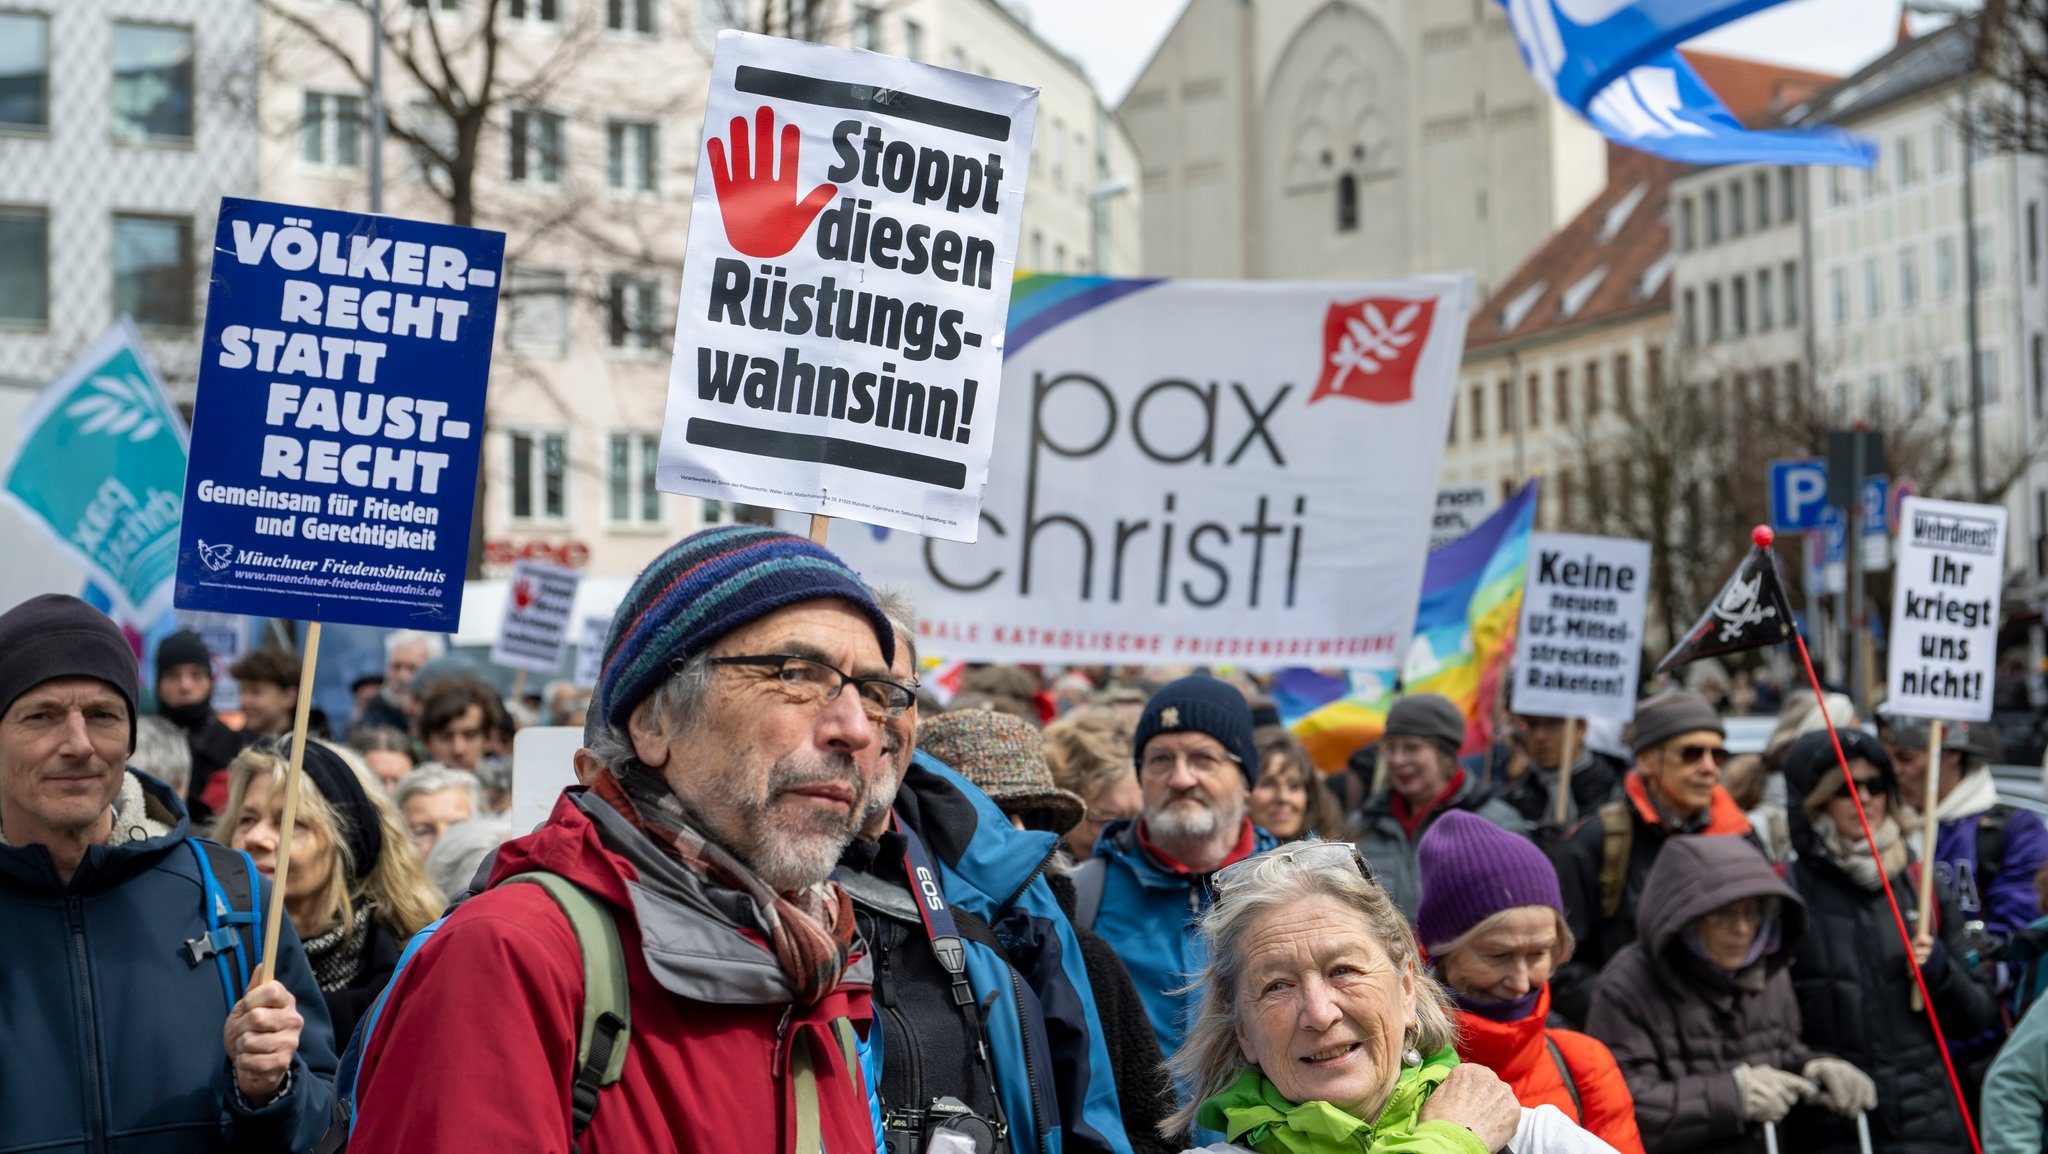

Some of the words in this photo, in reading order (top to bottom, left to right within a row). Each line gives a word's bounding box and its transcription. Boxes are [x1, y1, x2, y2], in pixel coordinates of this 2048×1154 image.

[828, 119, 1004, 214] Stoppt
[231, 216, 497, 291] VÖLKER-
[816, 197, 995, 290] diesen
[280, 279, 469, 342] RECHT
[707, 257, 982, 361] Rüstungs-
[218, 324, 387, 384] STATT
[265, 382, 471, 443] FAUST-
[697, 346, 979, 445] wahnsinn!
[1033, 371, 1295, 485] pax
[260, 434, 449, 495] RECHT
[197, 480, 321, 514] Gemeinsam
[327, 493, 358, 517] für
[363, 496, 439, 525] Frieden
[1785, 469, 1827, 524] P
[254, 515, 297, 538] und
[301, 516, 437, 551] Gerechtigkeit
[922, 493, 1307, 608] christi
[234, 549, 319, 572] Münchner
[320, 557, 447, 584] Friedensbündnis
[234, 569, 443, 598] www.muenchner-friedensbuendnis.de
[1538, 550, 1636, 592] Keine
[1932, 554, 1972, 588] Ihr
[1550, 592, 1618, 616] neuen
[1905, 589, 1992, 629] kriegt
[991, 625, 1162, 653] KATHOLISCHE
[1528, 614, 1634, 643] US-Mittel-
[1920, 633, 1970, 662] uns
[1529, 644, 1628, 670] strecken-
[1526, 666, 1625, 696] Raketen!
[1901, 665, 1983, 700] nicht!
[915, 866, 944, 911] EOS
[937, 1103, 967, 1113] Canon
